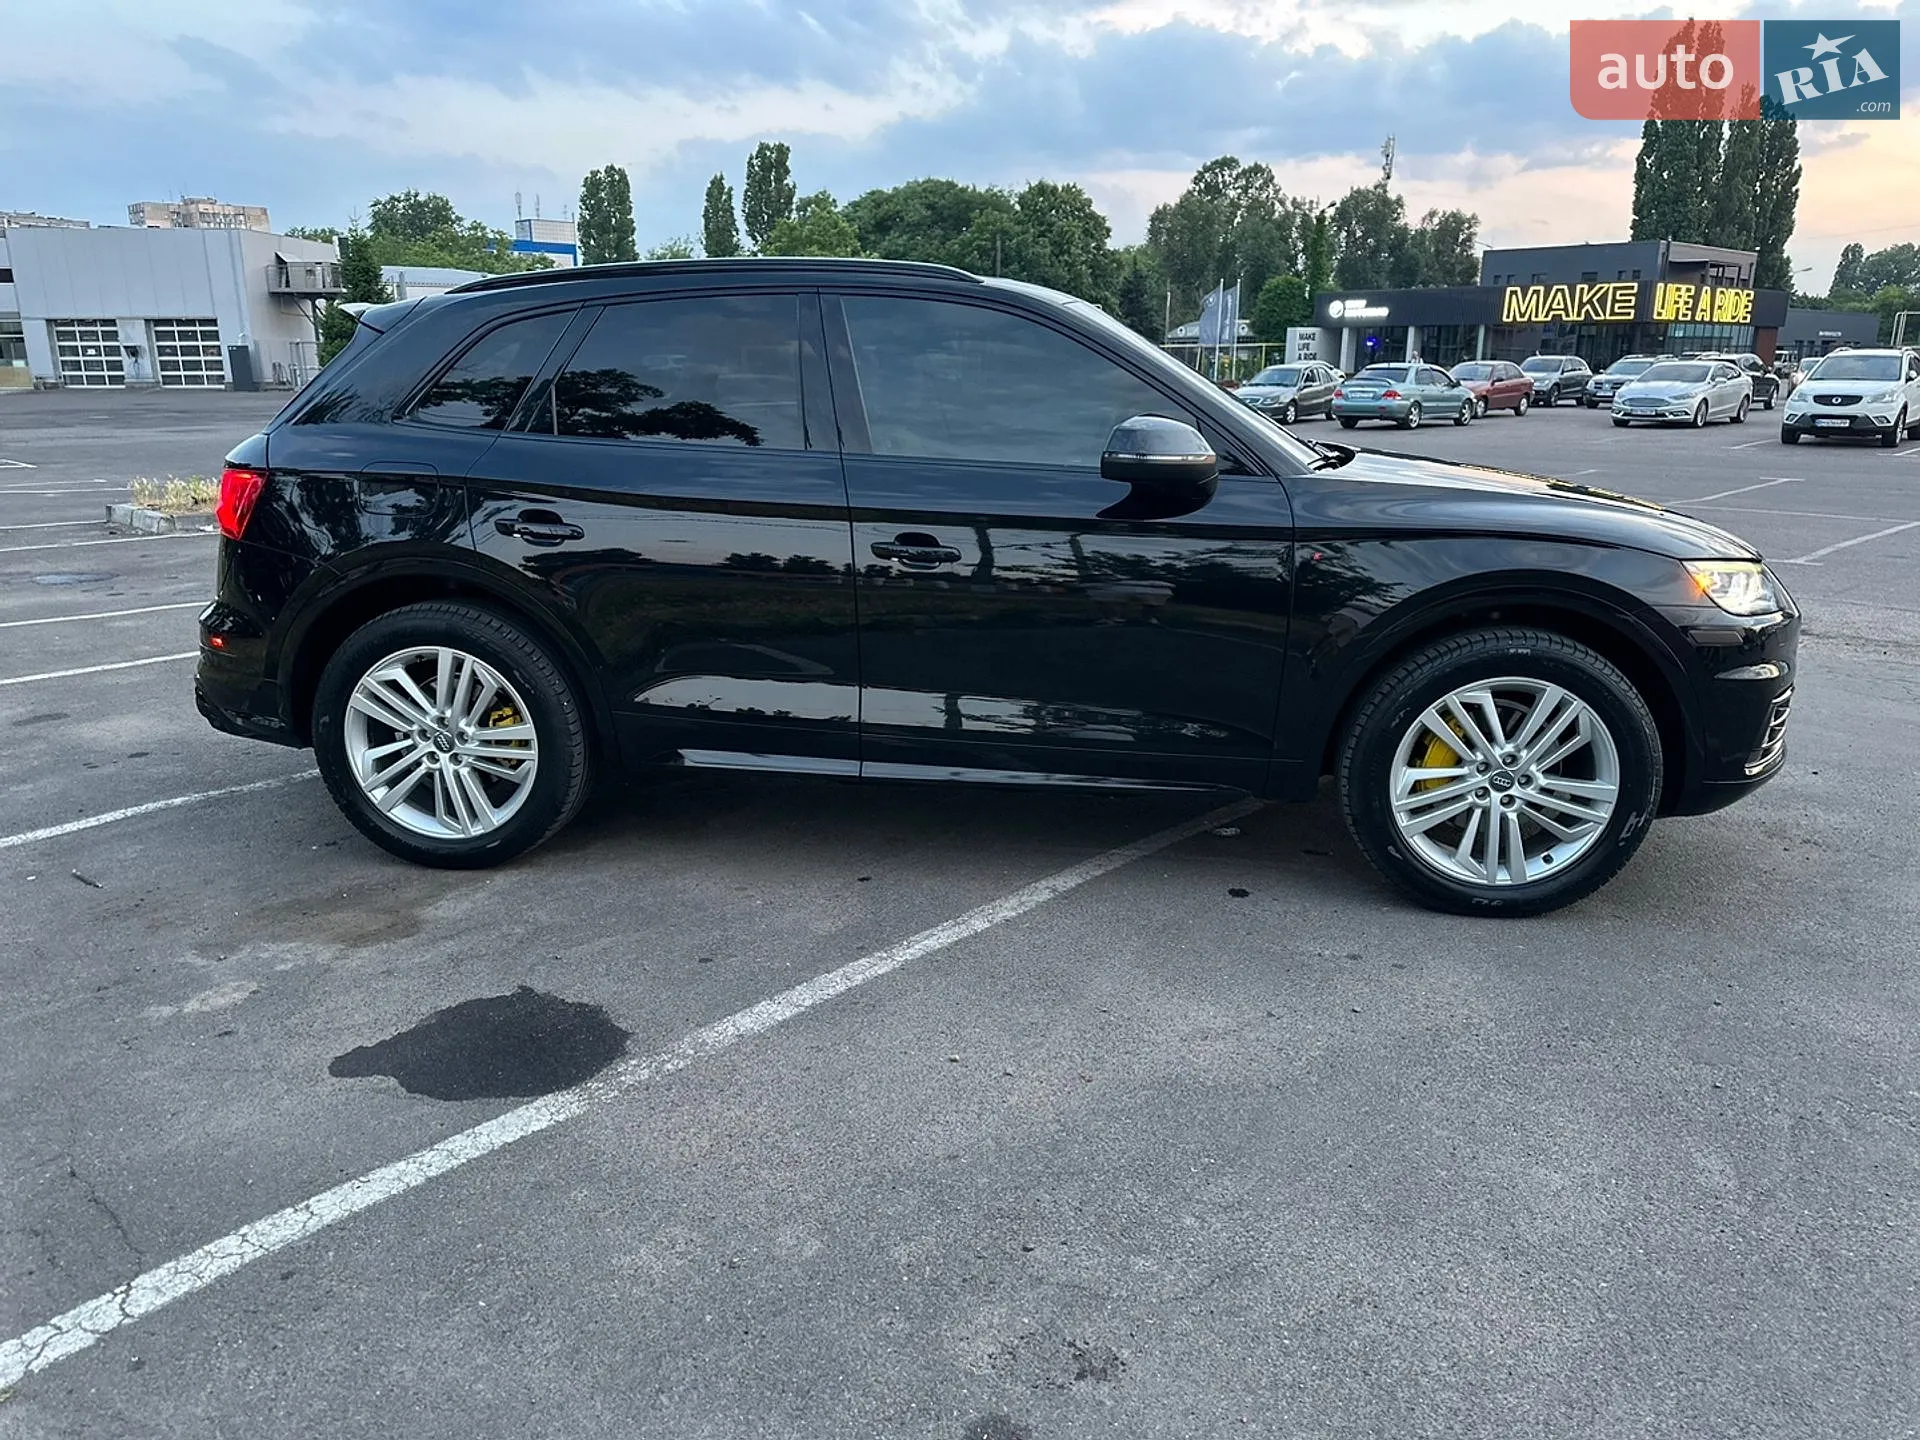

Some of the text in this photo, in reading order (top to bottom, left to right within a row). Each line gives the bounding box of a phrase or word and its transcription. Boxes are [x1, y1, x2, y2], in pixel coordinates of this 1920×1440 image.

[1502, 282, 1754, 324] MAKE LIFE A RIDE
